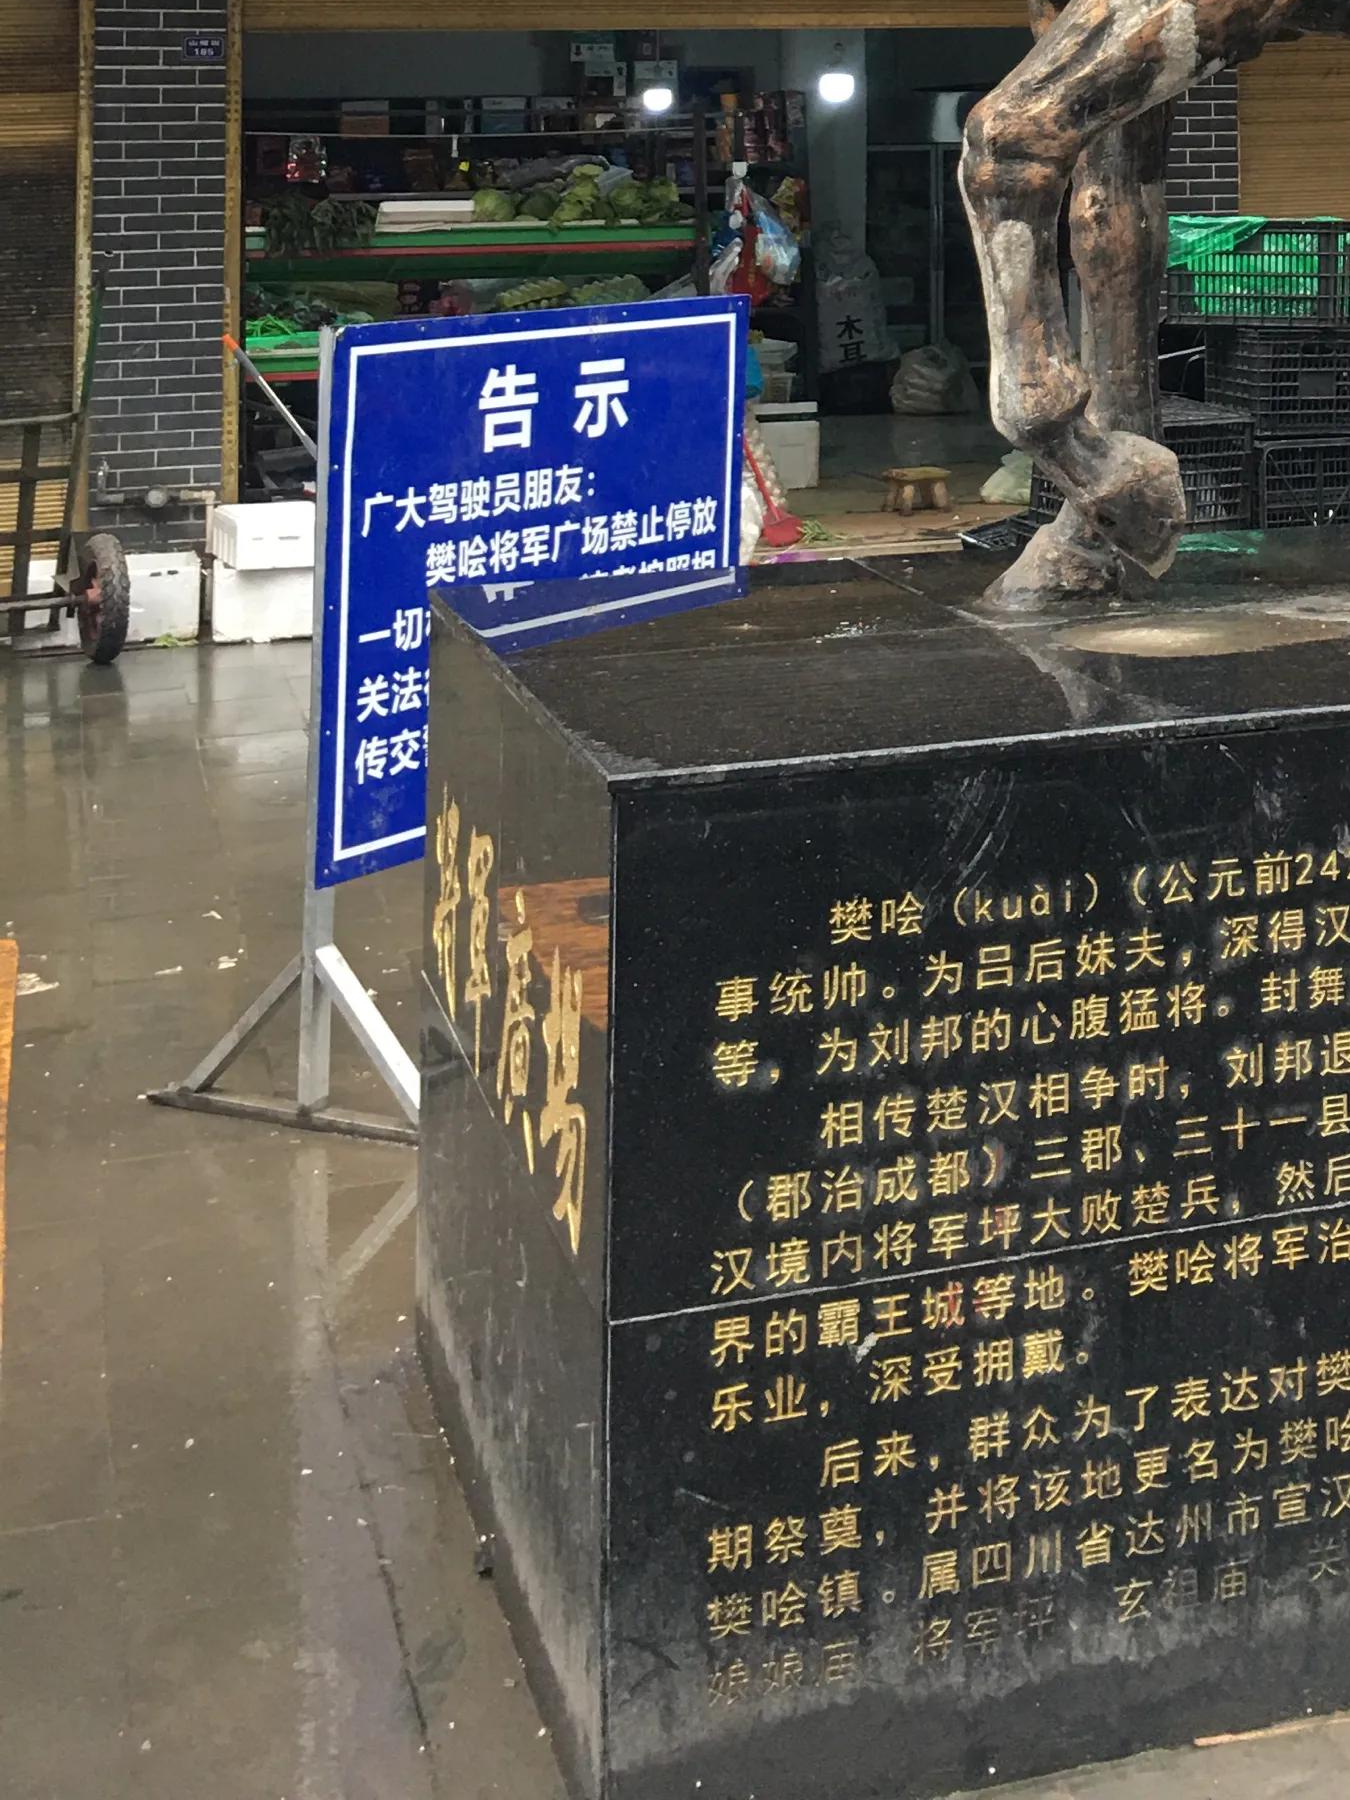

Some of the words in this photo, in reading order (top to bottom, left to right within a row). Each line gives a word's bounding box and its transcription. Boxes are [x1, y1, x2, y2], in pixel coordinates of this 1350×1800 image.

[836, 315, 867, 363] 木耳
[479, 357, 630, 452] 告示
[426, 496, 718, 586] 樊哙将军广场禁止停放
[359, 606, 430, 651] 一切
[356, 666, 430, 722] 关法
